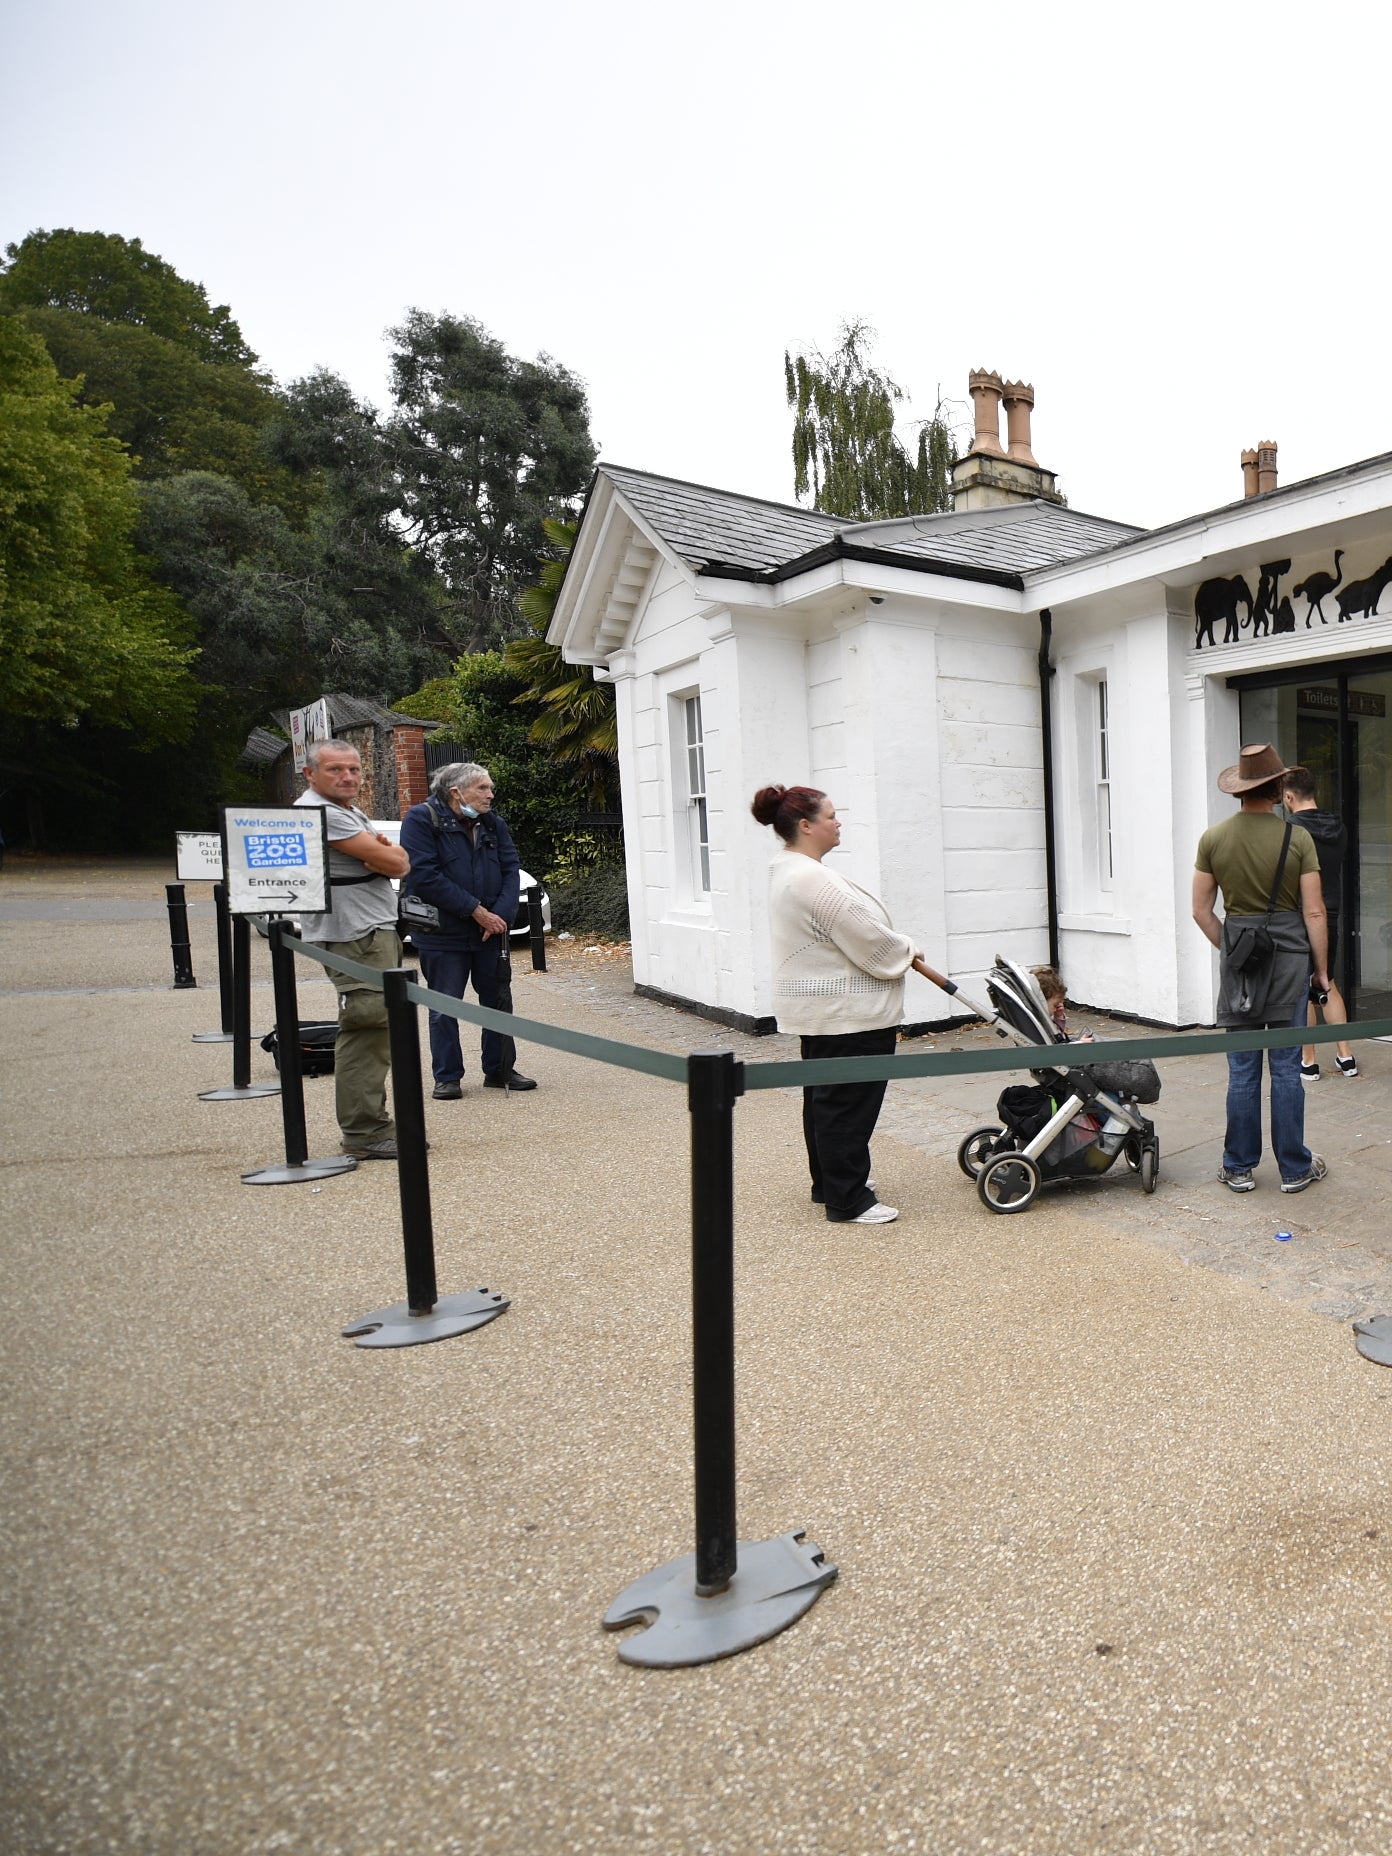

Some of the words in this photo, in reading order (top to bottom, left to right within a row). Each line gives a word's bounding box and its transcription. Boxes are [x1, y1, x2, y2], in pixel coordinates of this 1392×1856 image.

[1304, 690, 1338, 706] Toilets
[234, 818, 296, 828] Welcome
[300, 819, 314, 828] to
[247, 835, 300, 845] Bristol
[247, 843, 304, 859] ZOO
[251, 857, 303, 866] Gardens
[248, 878, 307, 887] Entrance
